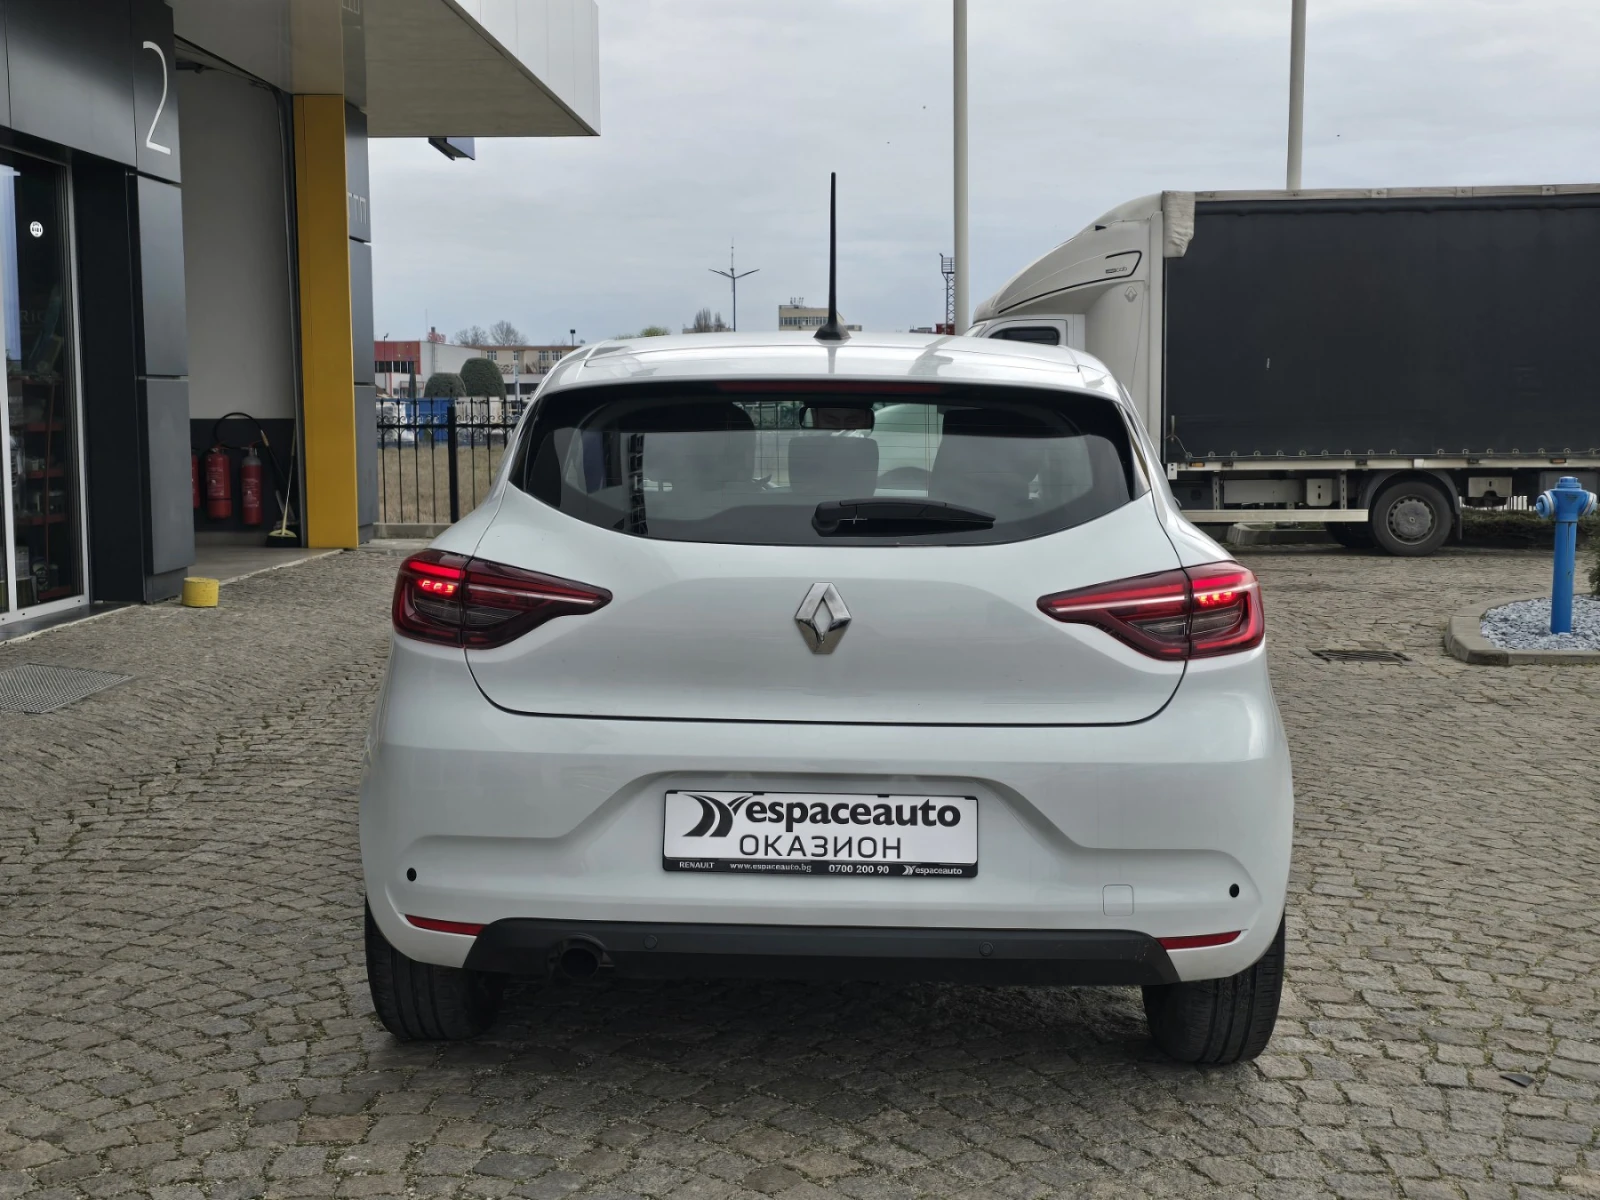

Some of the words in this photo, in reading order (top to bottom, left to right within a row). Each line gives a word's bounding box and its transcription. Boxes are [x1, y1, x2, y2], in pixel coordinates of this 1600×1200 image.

[142, 40, 172, 156] 2
[745, 798, 962, 832] espaceauto
[739, 833, 902, 860] ОКАЗИОН
[679, 861, 715, 869] RENAULT
[729, 863, 812, 873] www.espaceauto.bg
[828, 864, 853, 873] 0700
[855, 865, 875, 874] 200
[877, 866, 890, 875] 90
[914, 867, 963, 876] espaceauto
